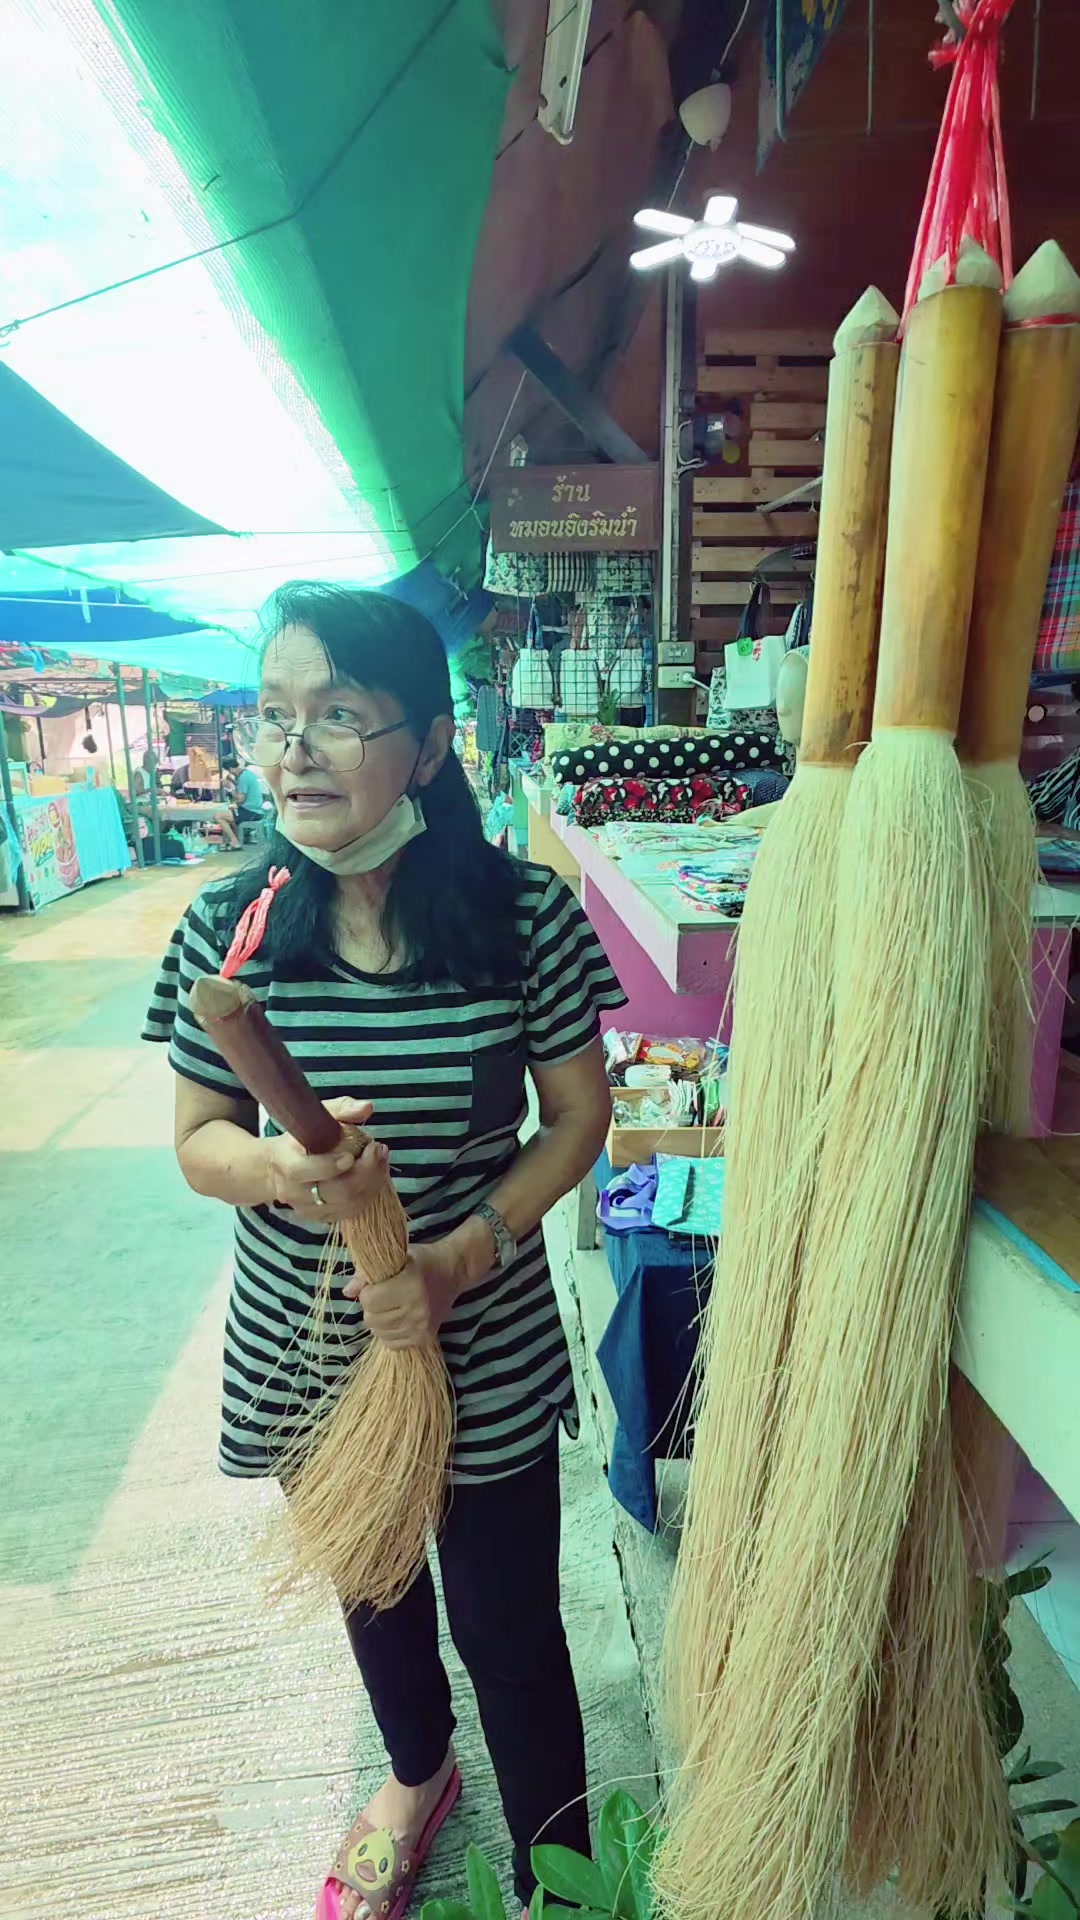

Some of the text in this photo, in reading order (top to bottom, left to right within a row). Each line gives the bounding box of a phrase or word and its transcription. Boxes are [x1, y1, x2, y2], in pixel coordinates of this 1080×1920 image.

[552, 475, 591, 502] ร้าน
[509, 506, 638, 538] หมอนอิงริมน้ำ
